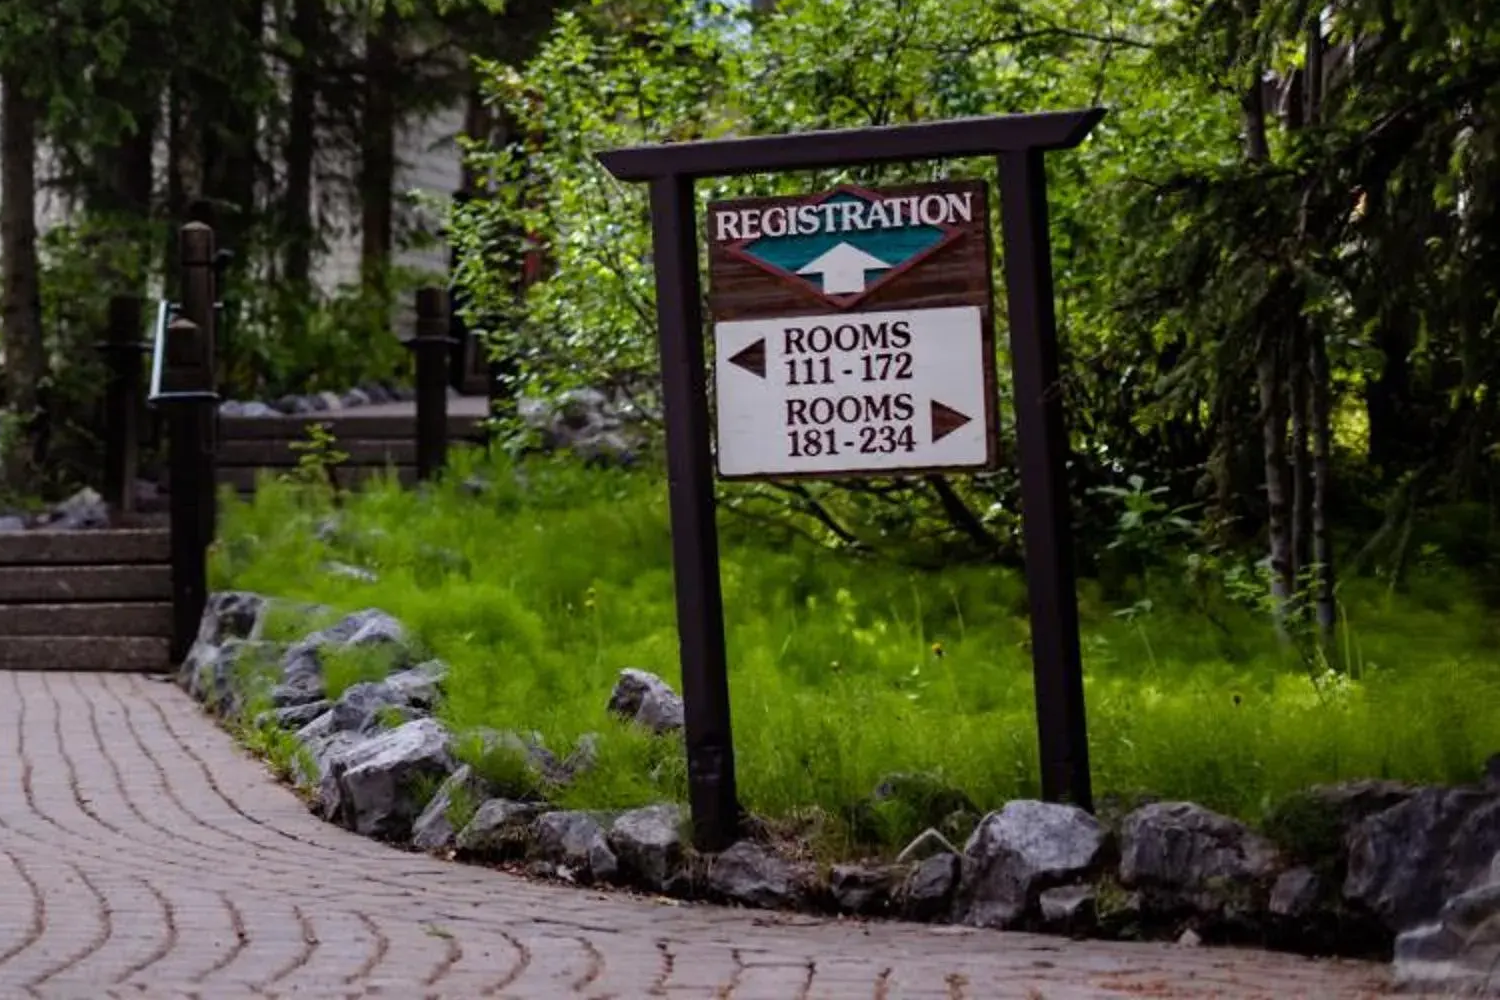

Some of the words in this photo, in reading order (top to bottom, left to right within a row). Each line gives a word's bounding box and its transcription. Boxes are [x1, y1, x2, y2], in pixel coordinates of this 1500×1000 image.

[715, 191, 973, 241] REGISTRATION
[783, 321, 911, 354] ROOMS
[786, 393, 915, 426] ROOMS
[788, 425, 916, 457] 181-234
